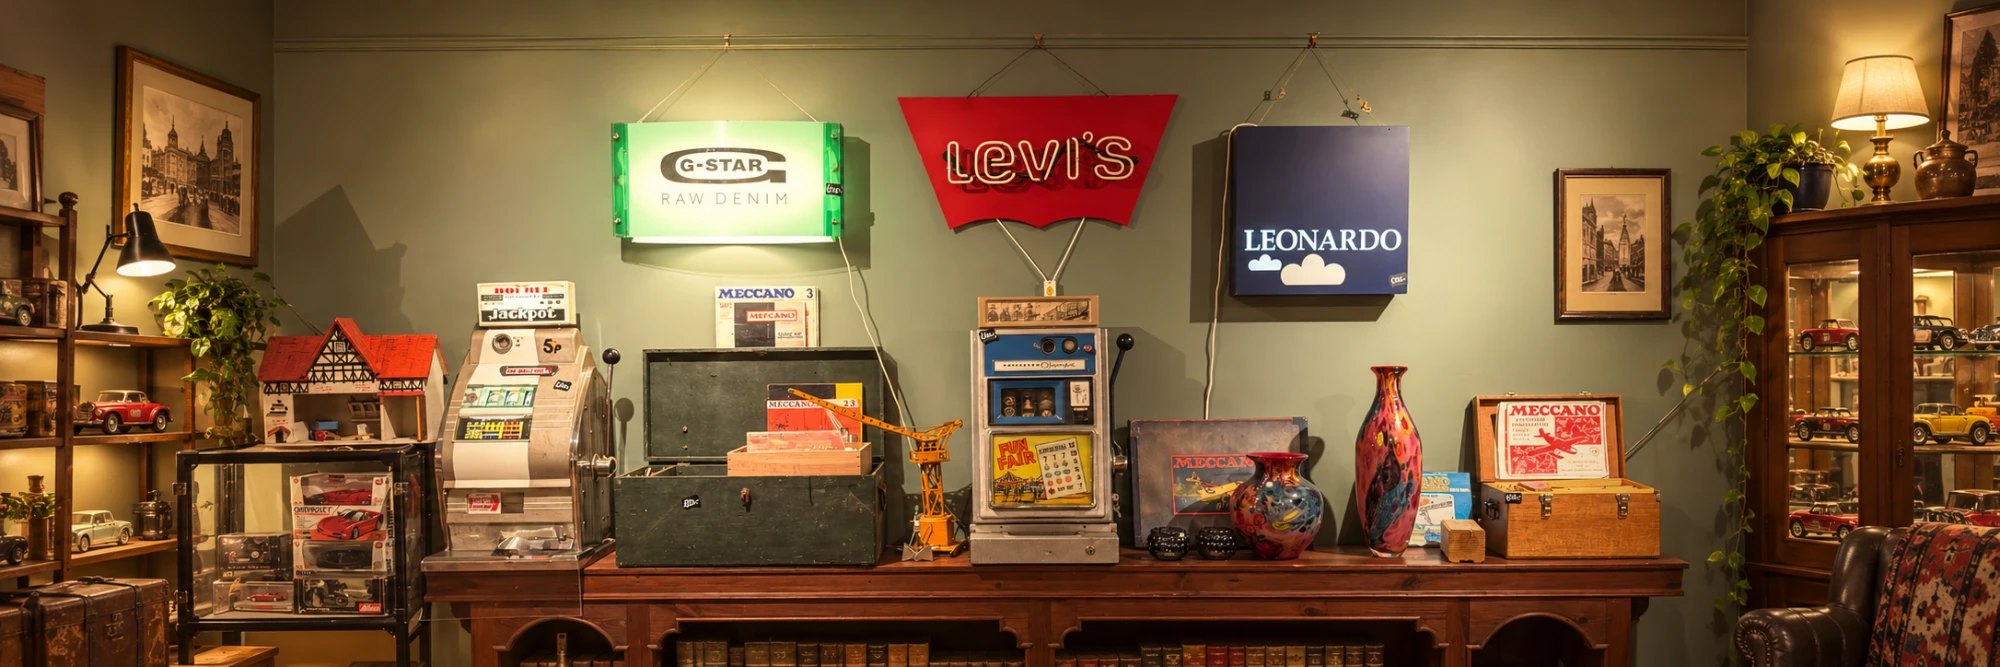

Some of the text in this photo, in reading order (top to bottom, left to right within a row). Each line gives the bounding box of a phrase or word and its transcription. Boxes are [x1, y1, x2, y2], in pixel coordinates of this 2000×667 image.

[680, 158, 763, 172] G-STAR
[661, 192, 788, 205] RAW DENIM
[1243, 228, 1402, 251] LEONARDO
[718, 288, 814, 299] MECCANO 3
[488, 307, 557, 321] Jackpot
[1509, 405, 1601, 416] MECCANO
[999, 438, 1029, 457] FUN
[997, 450, 1037, 471] FAIR
